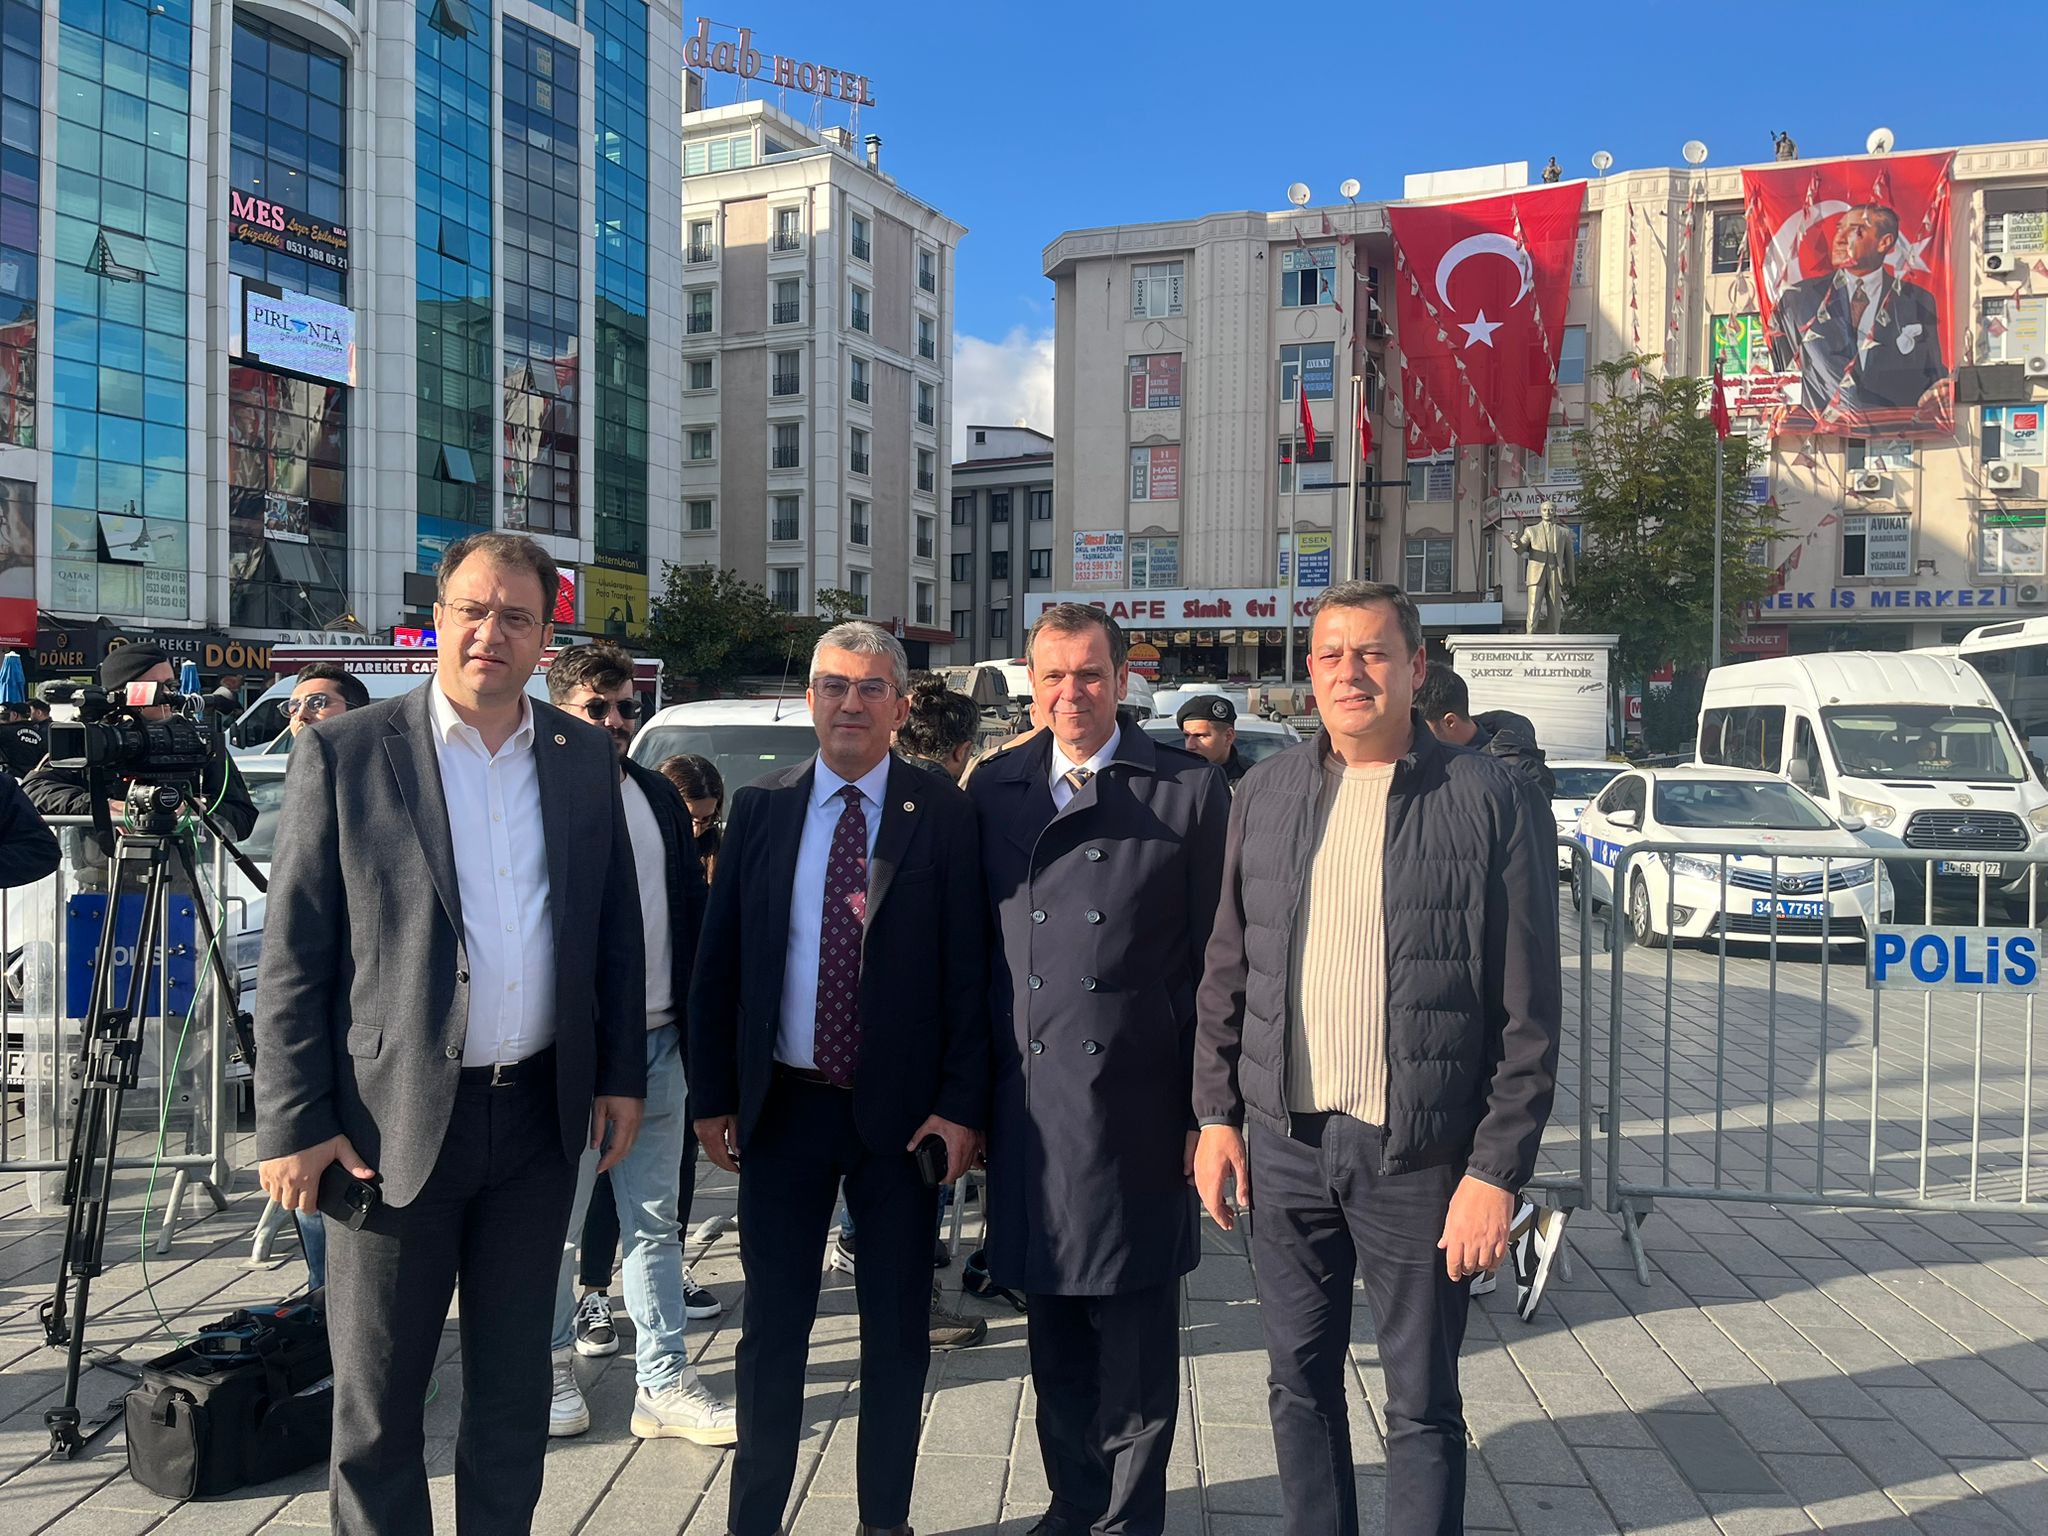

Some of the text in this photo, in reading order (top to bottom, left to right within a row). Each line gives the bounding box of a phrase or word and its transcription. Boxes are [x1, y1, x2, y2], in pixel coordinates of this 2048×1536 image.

[684, 17, 875, 107] dab HOTEL
[231, 191, 285, 231] MES
[238, 223, 281, 247] Güzellik
[286, 240, 307, 256] 0531
[338, 257, 348, 269] 21
[2014, 430, 2036, 438] CHP
[1871, 517, 1908, 531] AVUKAT
[1302, 536, 1328, 544] ESEN
[1871, 534, 1908, 543] ARABULUCU
[1075, 561, 1091, 571] 0212
[58, 570, 91, 581] QATAR
[1075, 571, 1091, 580] 0532
[1747, 591, 1815, 609] NEK
[1871, 586, 2007, 609] MERKEZİ
[1183, 598, 1232, 619] Simit
[1246, 596, 1276, 617] Evi
[1293, 597, 1314, 617] KÖ
[1729, 634, 1780, 645] ARKET
[39, 649, 84, 666] DÖNER
[206, 637, 273, 669] DÖN
[1471, 651, 1595, 662] EGEMENLİK KAYITSIZ
[344, 662, 438, 673] HAREKET CAF
[1471, 667, 1592, 679] ŞARTSIZ MİLLETİNDİR
[1944, 862, 1956, 872] 34
[1960, 862, 1971, 873] GB
[1756, 901, 1771, 913] 34
[1788, 903, 1824, 916] 77515
[95, 941, 163, 967] OLS
